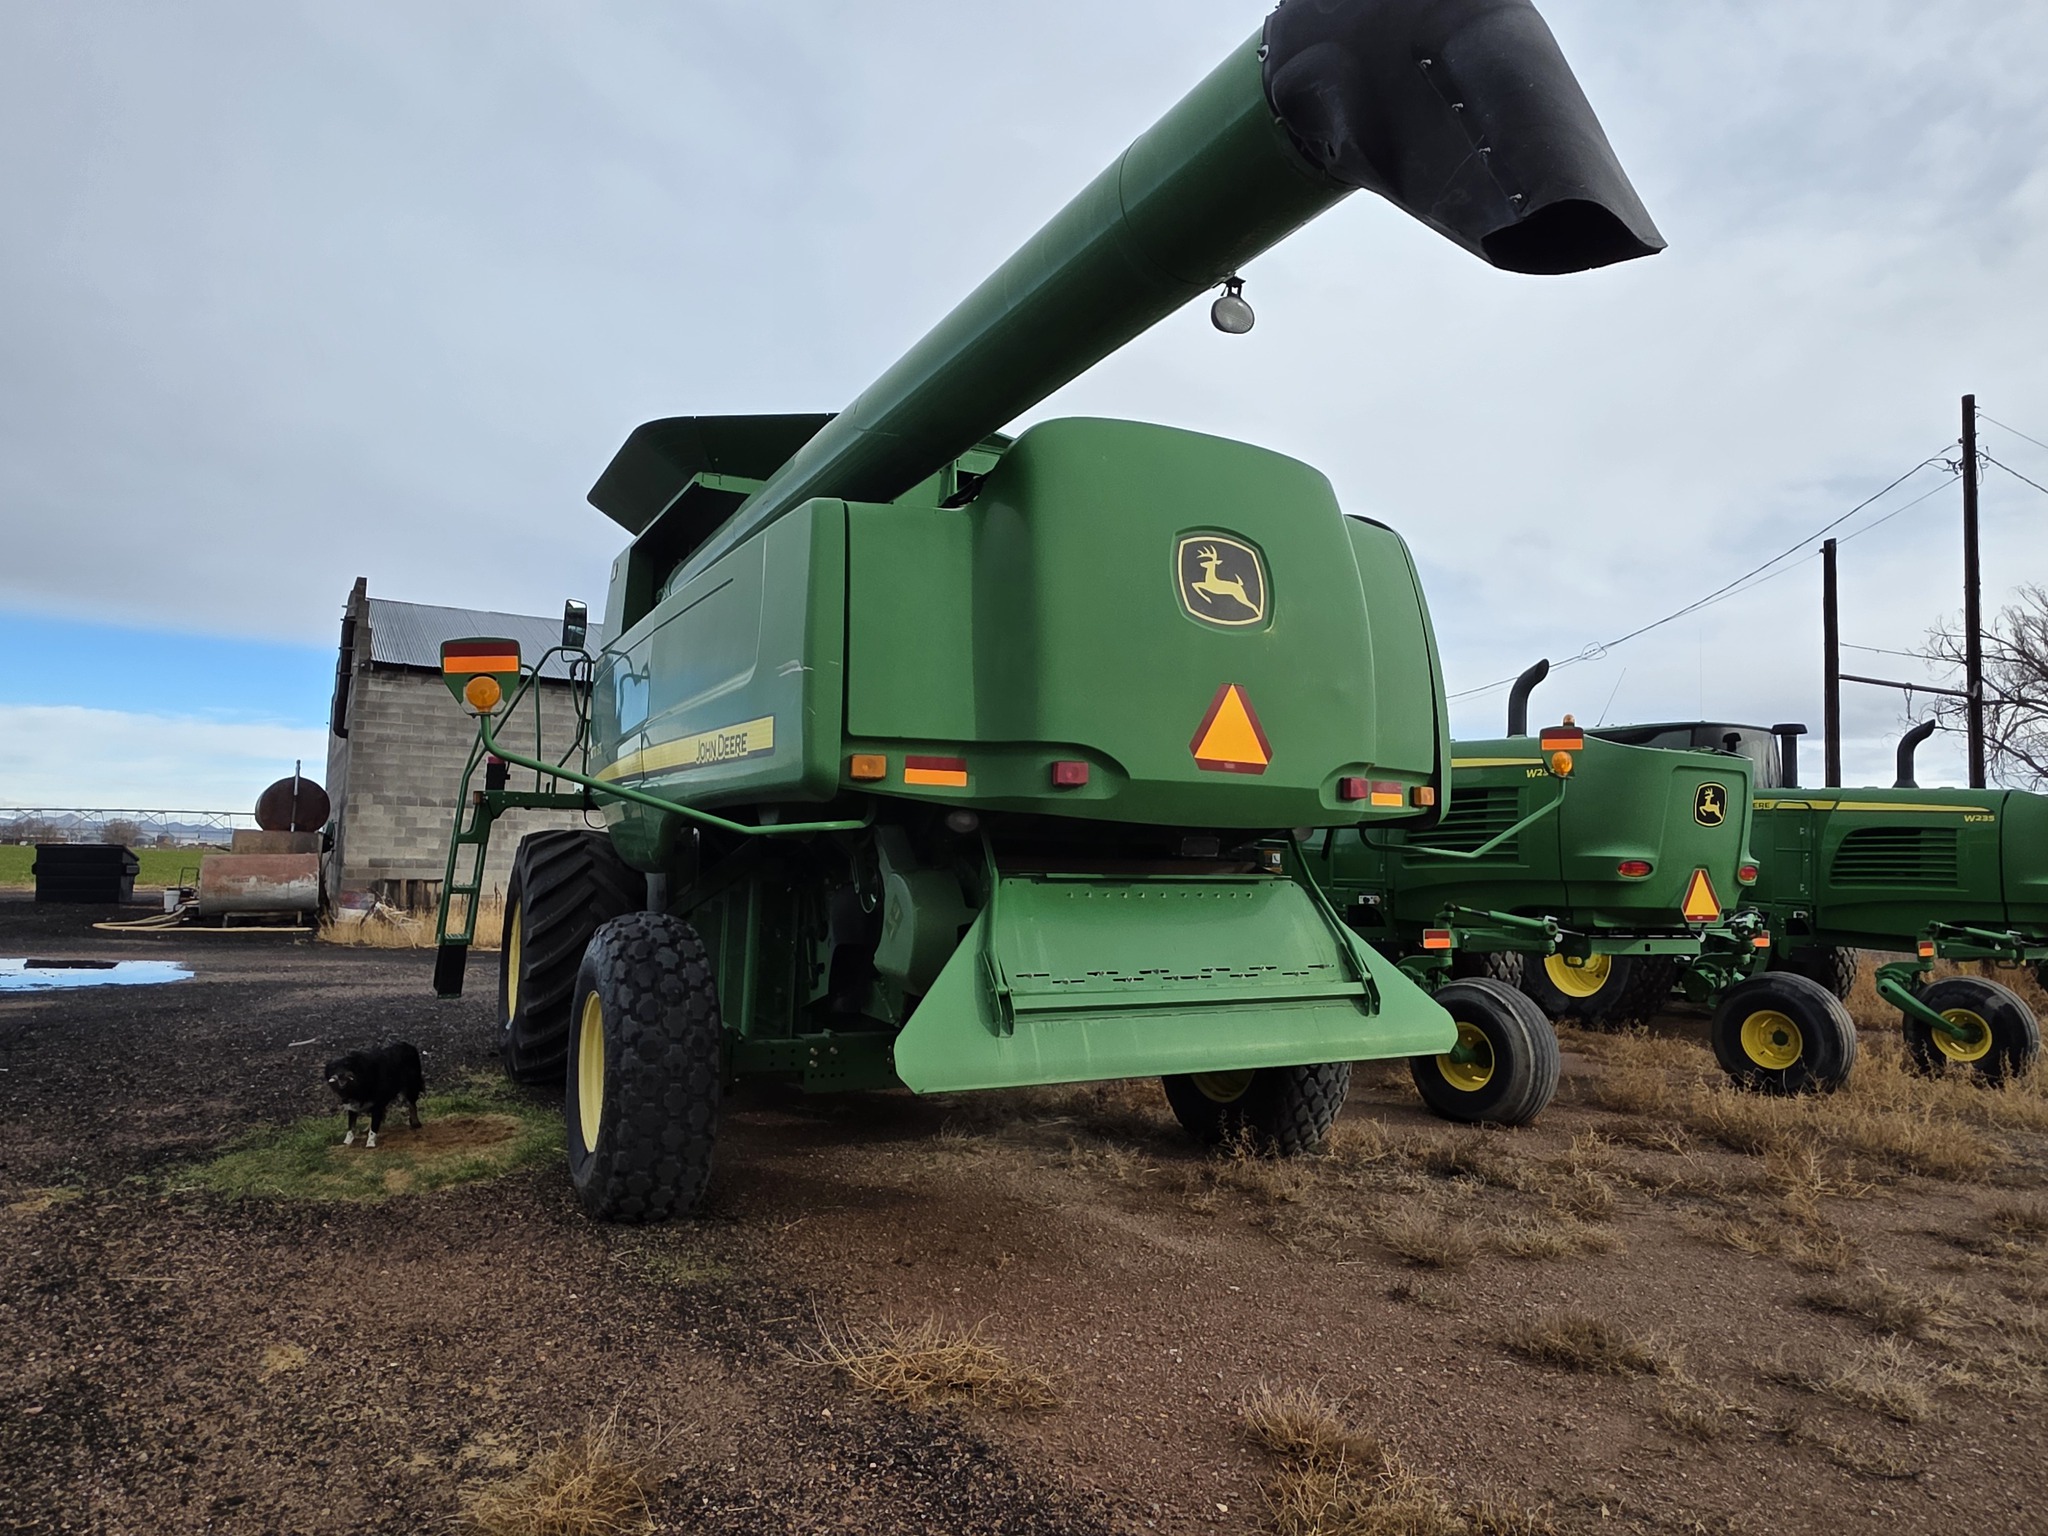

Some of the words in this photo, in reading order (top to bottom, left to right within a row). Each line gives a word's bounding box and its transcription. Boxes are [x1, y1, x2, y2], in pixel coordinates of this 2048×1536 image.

[696, 739, 717, 763] JOHN
[717, 732, 748, 758] DEERE
[1963, 814, 1995, 822] W235
